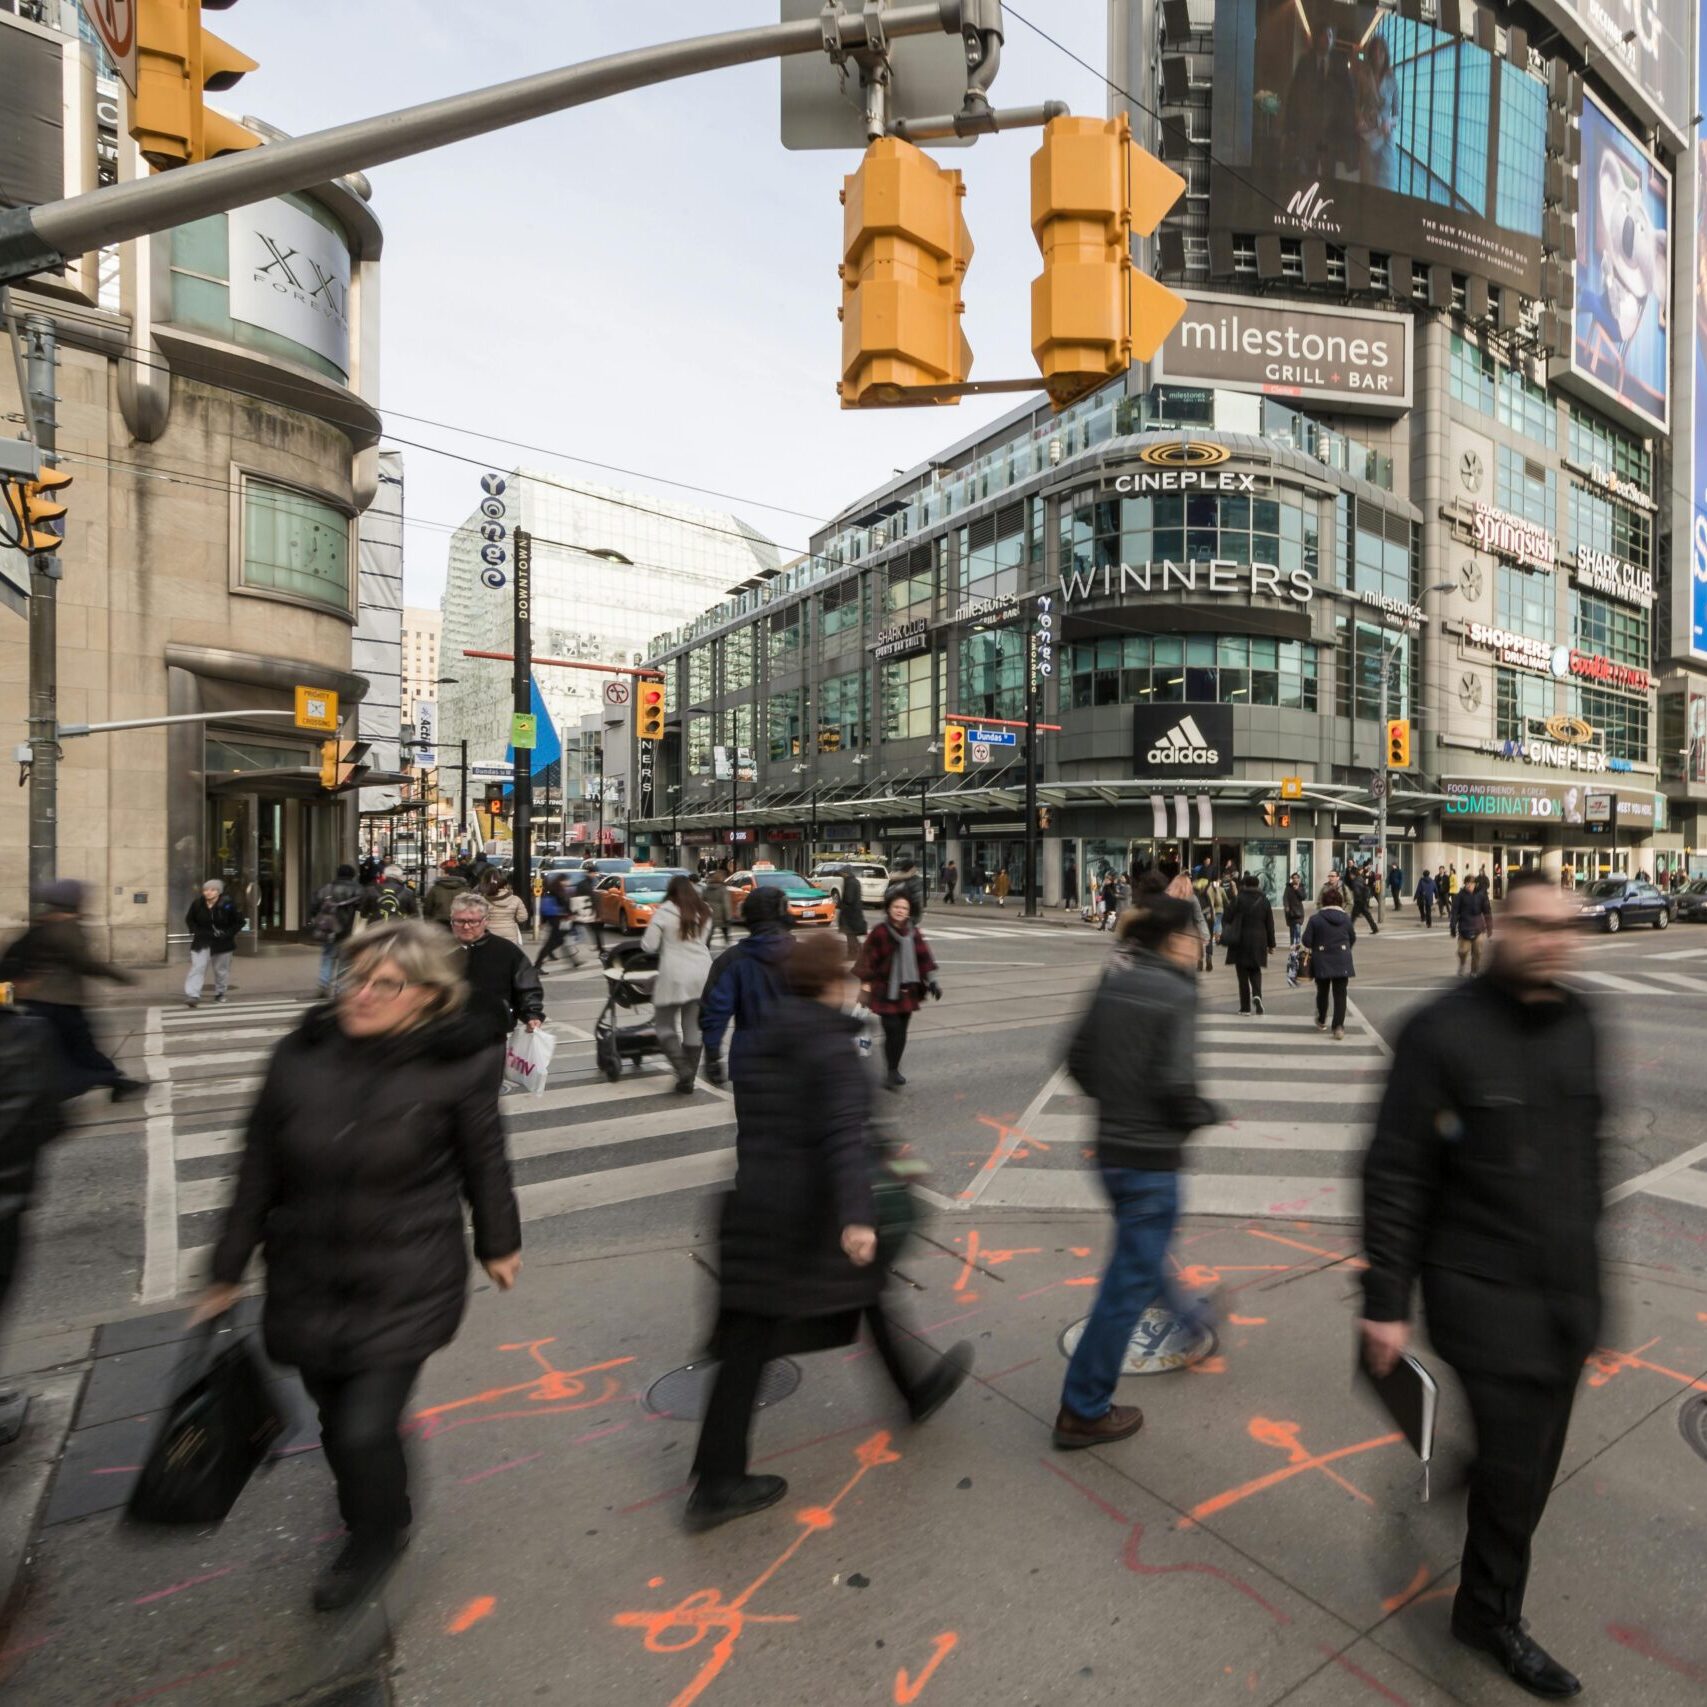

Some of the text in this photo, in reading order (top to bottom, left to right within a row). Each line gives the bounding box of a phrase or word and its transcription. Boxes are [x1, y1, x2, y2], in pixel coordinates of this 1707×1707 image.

[1287, 182, 1334, 232] Mr.
[1422, 218, 1528, 264] THE NEW FRAGRANCE FOR MEN
[1426, 234, 1458, 250] MONOGRAM
[1461, 245, 1477, 257] YOURS
[1181, 315, 1389, 368] milestones
[1265, 364, 1325, 385] GRILL
[1169, 391, 1206, 399] milestones
[1115, 471, 1255, 493] CINEPLEX
[518, 538, 529, 620] DOWNTOWN
[1059, 558, 1314, 602] WINNERS
[1578, 544, 1620, 584] SHARK
[1623, 563, 1652, 595] CLUB
[955, 591, 1016, 622] milestones
[1364, 589, 1421, 621] milestones
[877, 618, 925, 645] SHARK CLUB
[1037, 595, 1052, 677] Yonge
[1470, 622, 1551, 660] SHOPPERS
[875, 641, 893, 658] SPORTS
[1504, 651, 1551, 674] DRUG MART
[420, 718, 431, 753] Actin
[976, 731, 1003, 742] Dundas
[1147, 745, 1219, 764] adidas
[1530, 742, 1607, 772] CINEPLEX
[475, 767, 499, 776] Dundas
[1447, 783, 1468, 793] FOOD
[1469, 784, 1485, 794] AND
